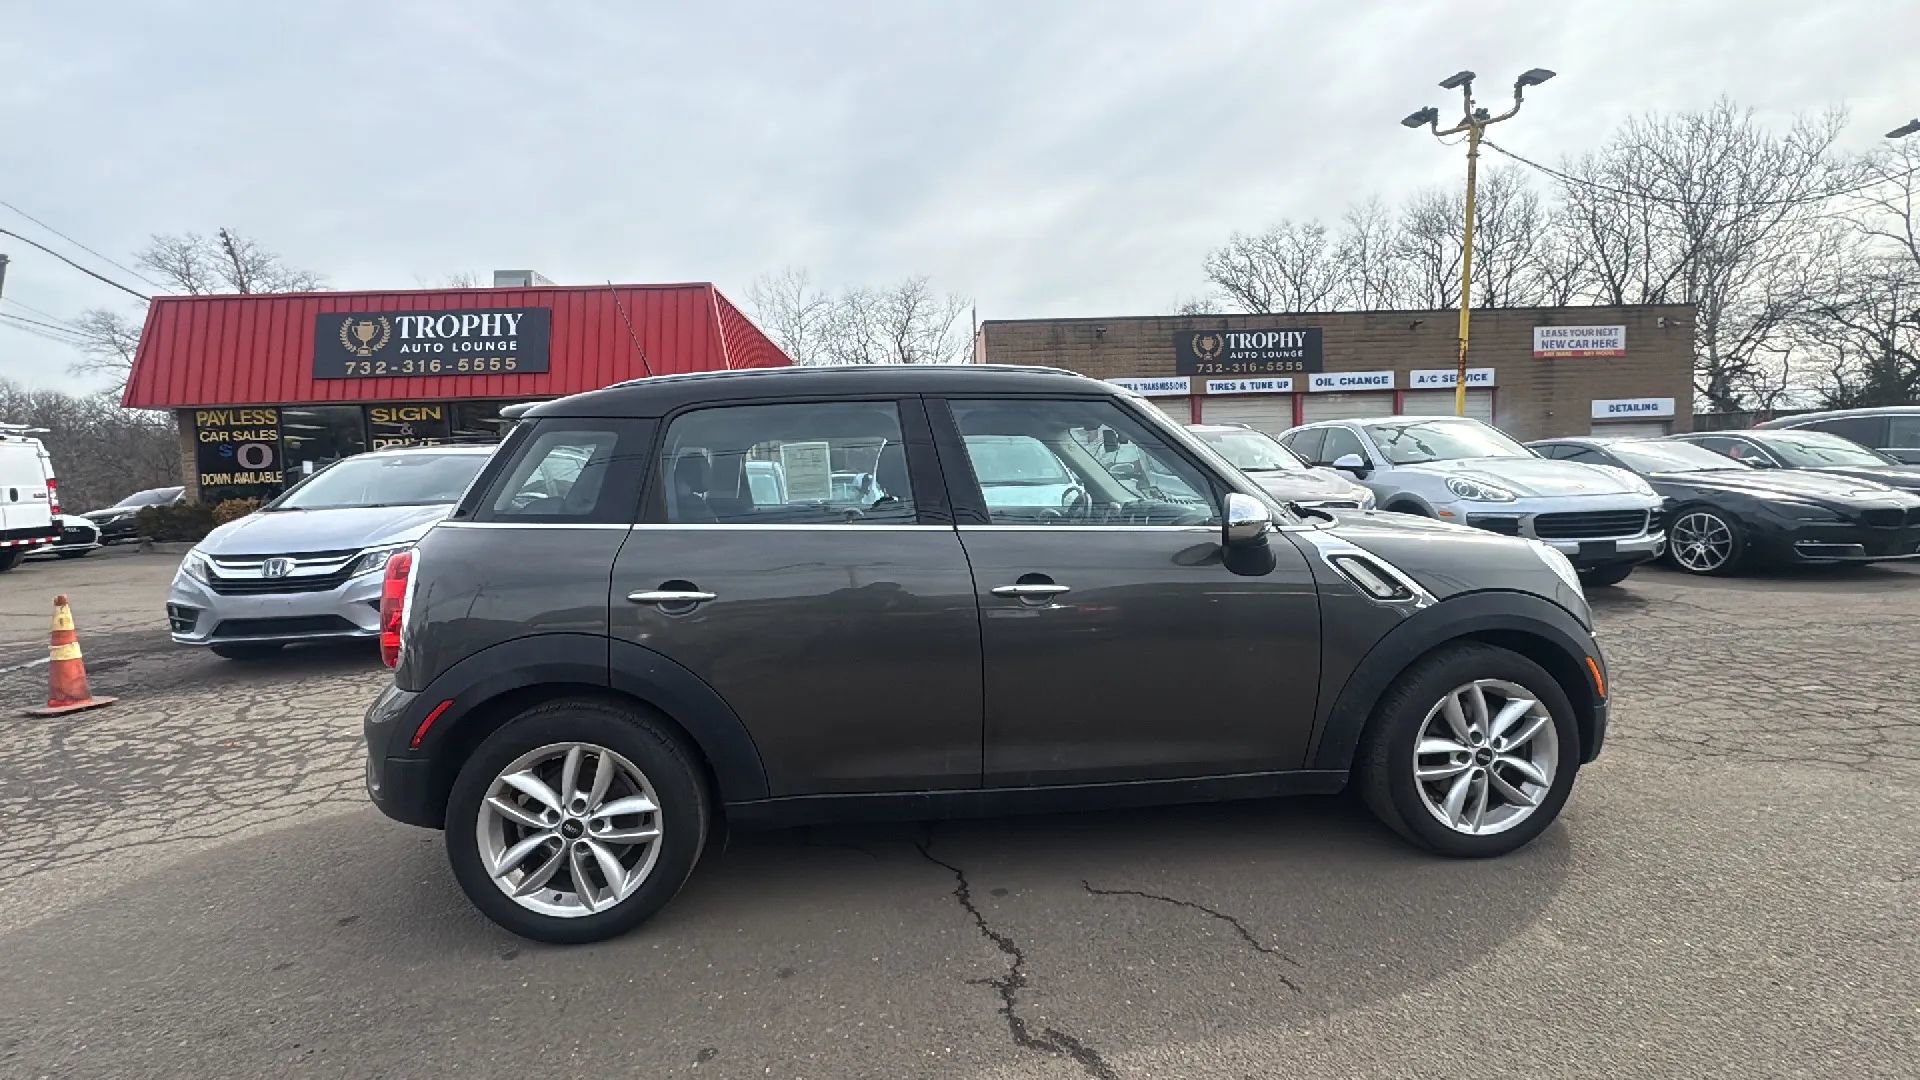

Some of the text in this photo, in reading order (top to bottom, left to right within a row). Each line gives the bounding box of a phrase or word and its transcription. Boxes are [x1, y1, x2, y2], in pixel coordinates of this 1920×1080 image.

[395, 313, 523, 339] TROPHY
[1541, 327, 1619, 337] LEASE YOUR NEXT
[1226, 331, 1306, 349] TROPHY
[1541, 339, 1619, 349] NEW CAR HERE
[400, 340, 517, 354] AUTO LOUNGE
[1230, 350, 1303, 360] AUTO LOUNGE
[345, 357, 517, 375] 732-316-5555
[1196, 361, 1304, 373] 732-316-5555
[1315, 375, 1389, 387] OIL CHANGE
[1417, 373, 1488, 384] A/C SEVICE
[1140, 381, 1188, 391] TRANSMISSIONS
[1209, 380, 1289, 391] TIRES & TUNE UP
[370, 406, 441, 422] SIGN
[1609, 403, 1658, 413] DETAILING
[195, 409, 278, 427] PAYLESS
[400, 422, 413, 435] &
[199, 429, 278, 442] CAR SALES
[201, 471, 283, 486] DOWN AVAILABLE
